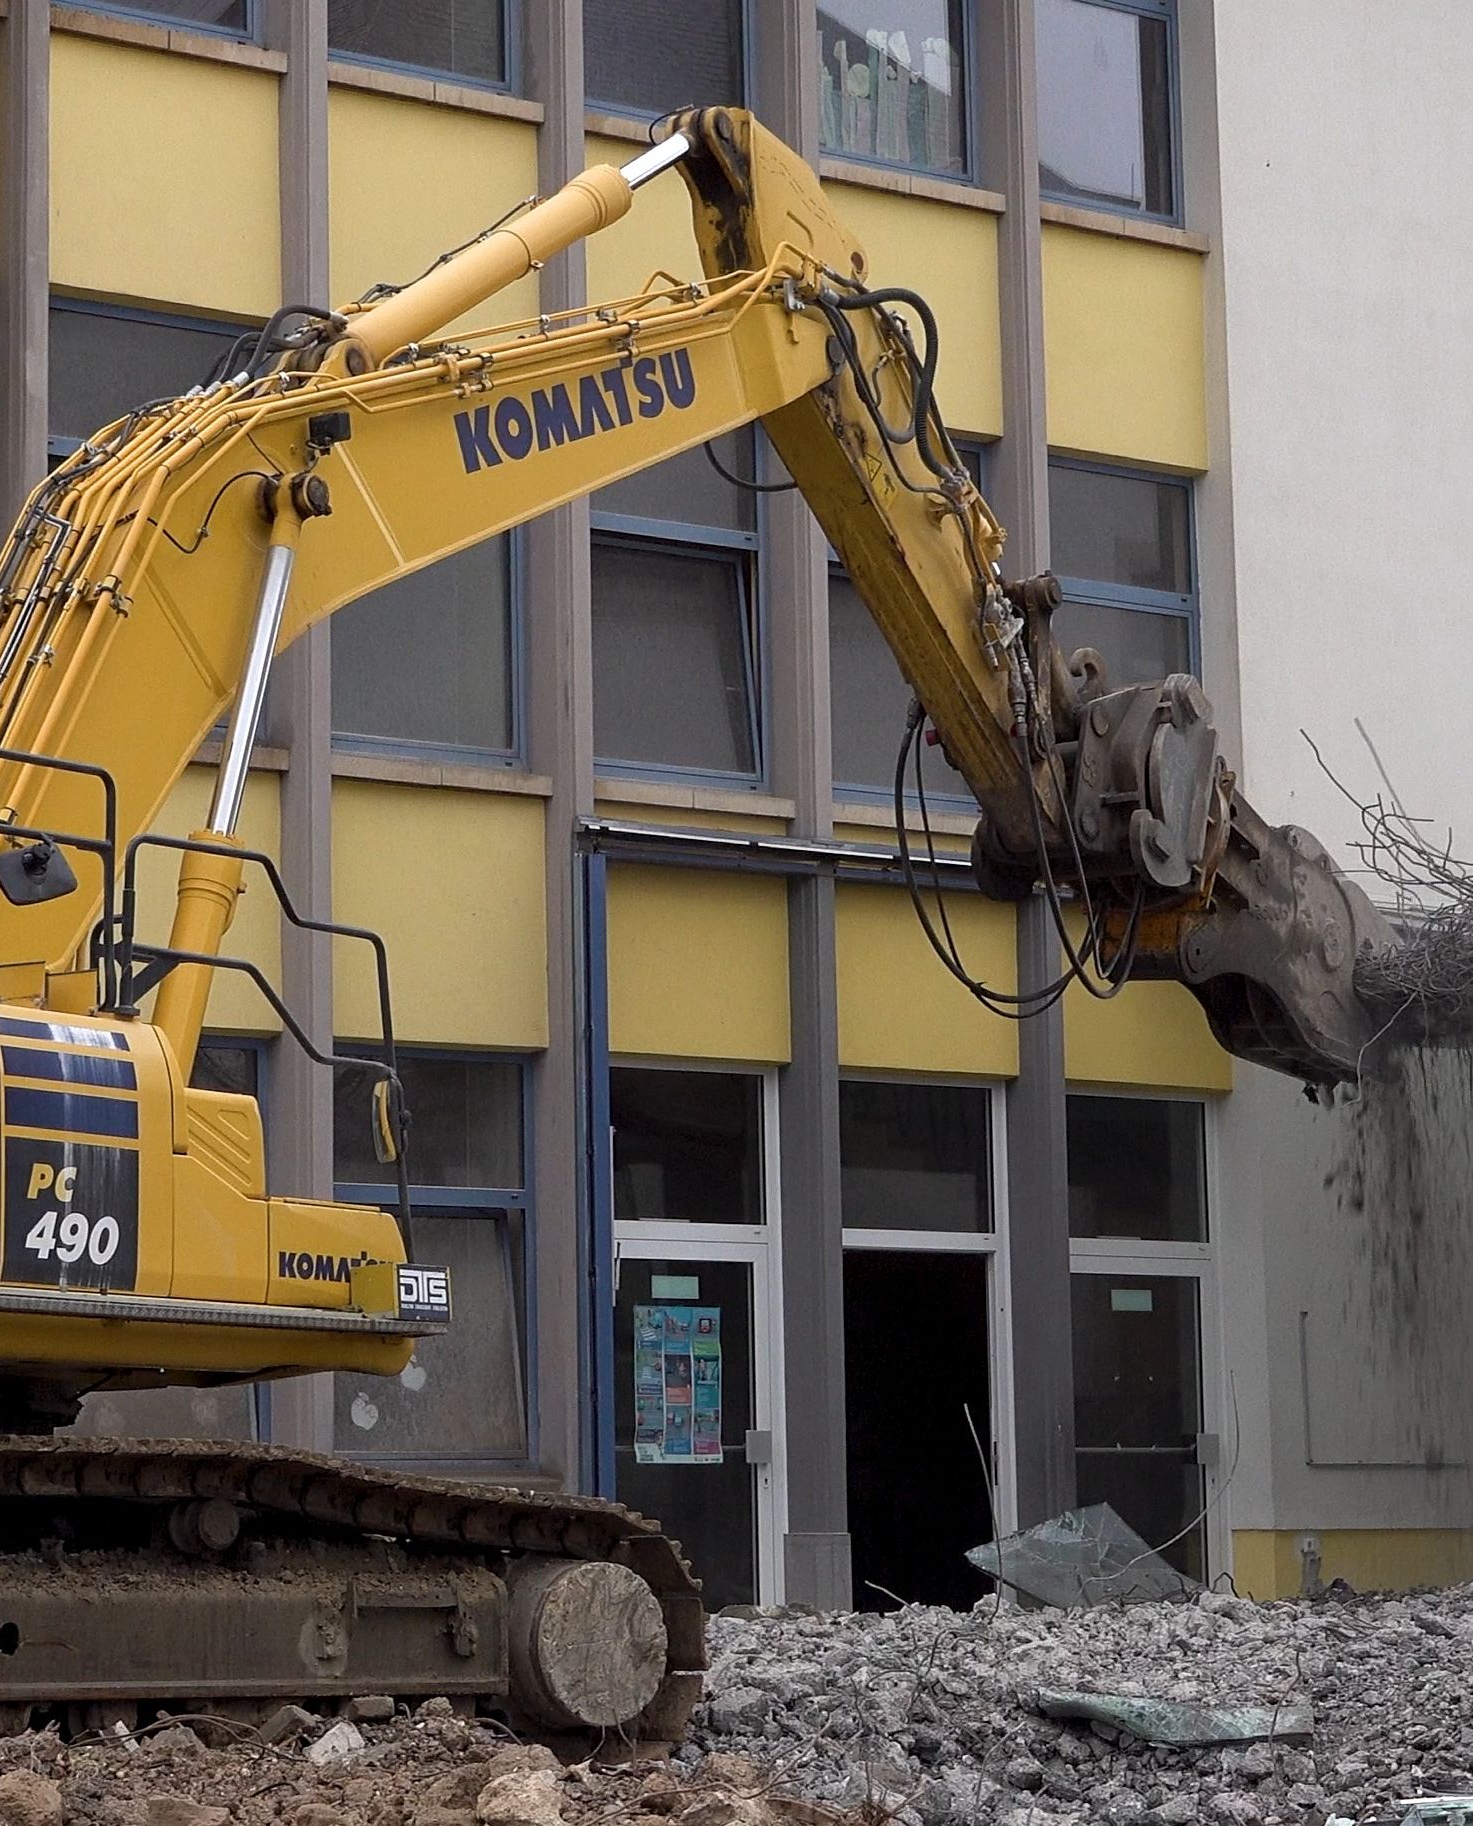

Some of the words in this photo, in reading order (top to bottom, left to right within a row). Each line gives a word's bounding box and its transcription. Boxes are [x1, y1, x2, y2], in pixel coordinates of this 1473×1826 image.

[454, 347, 696, 474] KOMATSU
[27, 1163, 77, 1202] PC
[25, 1211, 120, 1266] 490
[399, 1268, 447, 1304] DTS
